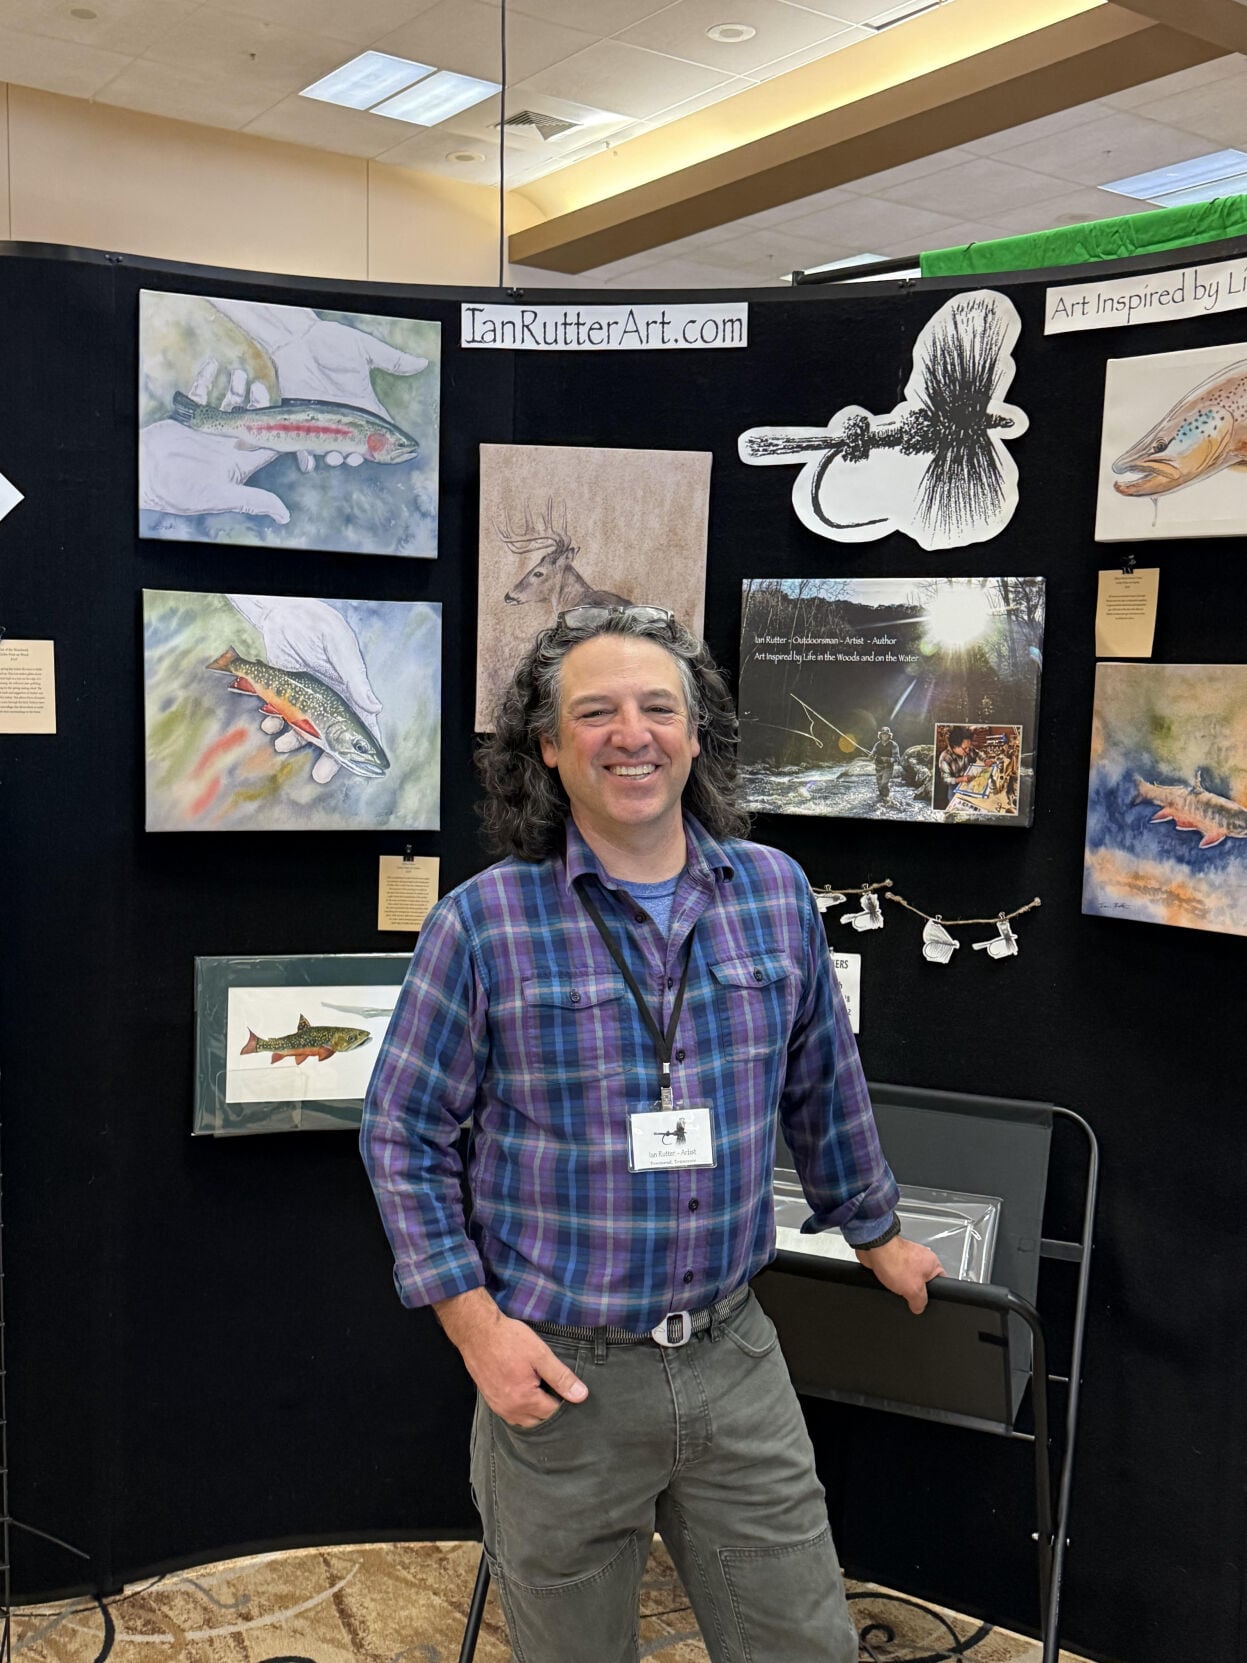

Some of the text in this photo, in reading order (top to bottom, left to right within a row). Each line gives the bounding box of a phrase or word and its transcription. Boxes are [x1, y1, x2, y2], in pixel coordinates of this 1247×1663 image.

[1051, 296, 1089, 320] Art
[1096, 271, 1185, 324] Inspired
[1194, 268, 1219, 311] by
[464, 306, 743, 345] IanRutterArt.com
[754, 635, 765, 644] Ian
[766, 635, 787, 644] Rutter
[793, 632, 839, 644] Outdoorsman
[844, 636, 864, 645] Artist
[872, 634, 897, 645] Author
[754, 652, 765, 660] Art
[766, 650, 792, 664] Inspired
[793, 650, 802, 664] by
[803, 650, 816, 661] Life
[817, 652, 824, 661] in
[824, 651, 836, 661] the
[836, 651, 860, 662] Woods
[861, 651, 875, 662] and
[885, 651, 897, 662] the
[898, 654, 919, 663] Water
[832, 959, 849, 969] ERS
